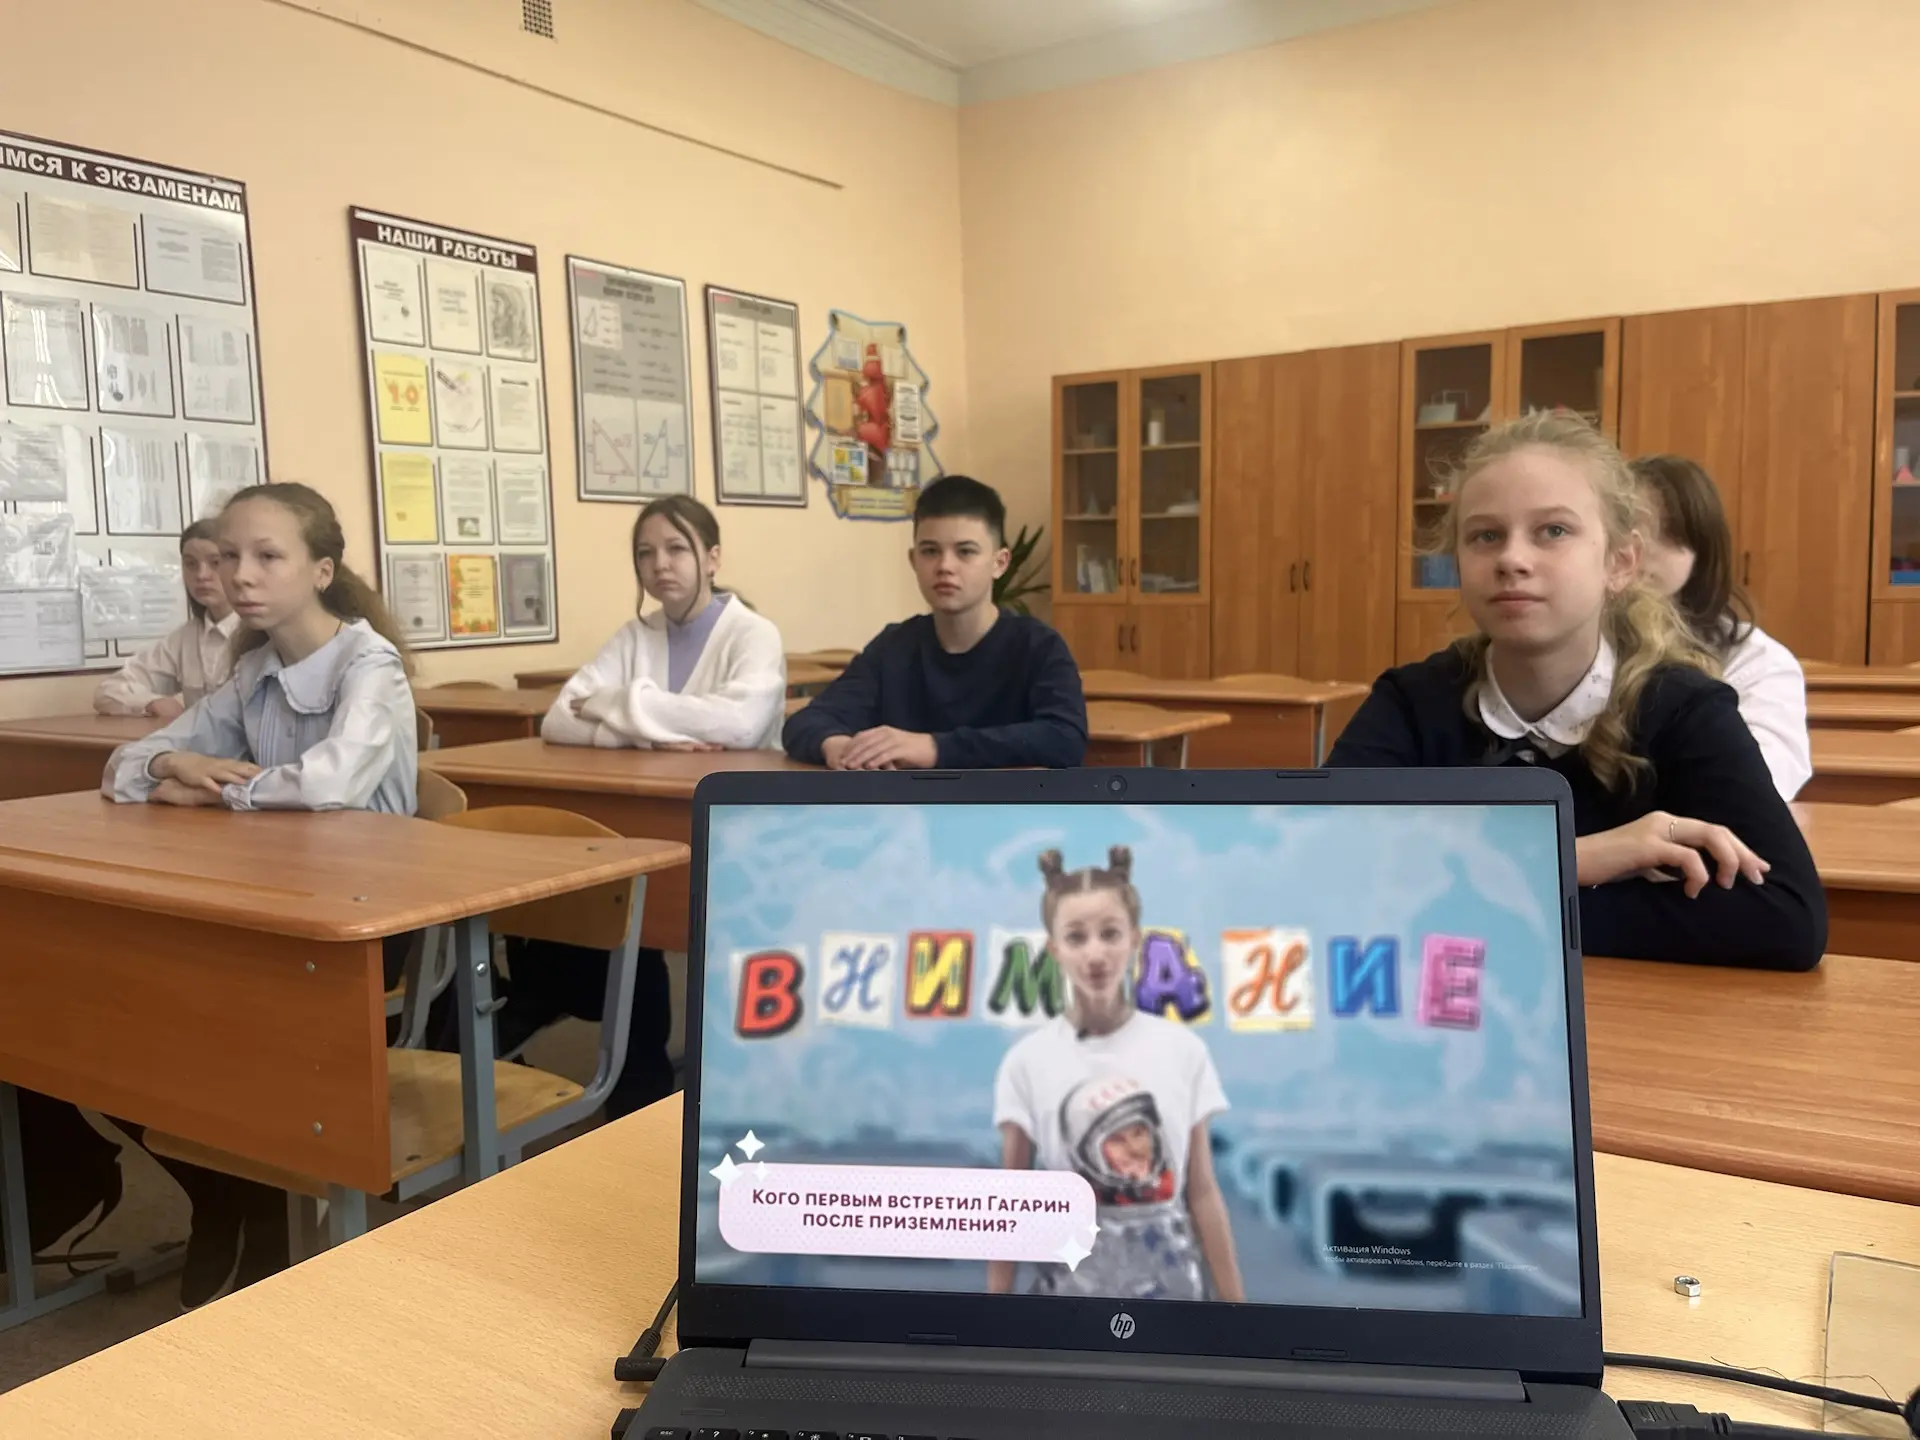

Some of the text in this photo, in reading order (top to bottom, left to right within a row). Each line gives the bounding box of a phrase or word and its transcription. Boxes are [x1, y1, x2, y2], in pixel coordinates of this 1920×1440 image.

[0, 146, 241, 212] МСЯ К ЭКЗАМЕНАМ
[377, 224, 518, 269] НАШИ РАБОТЫ
[1323, 1244, 1411, 1255] Активация Windows
[1110, 1312, 1136, 1339] hp
